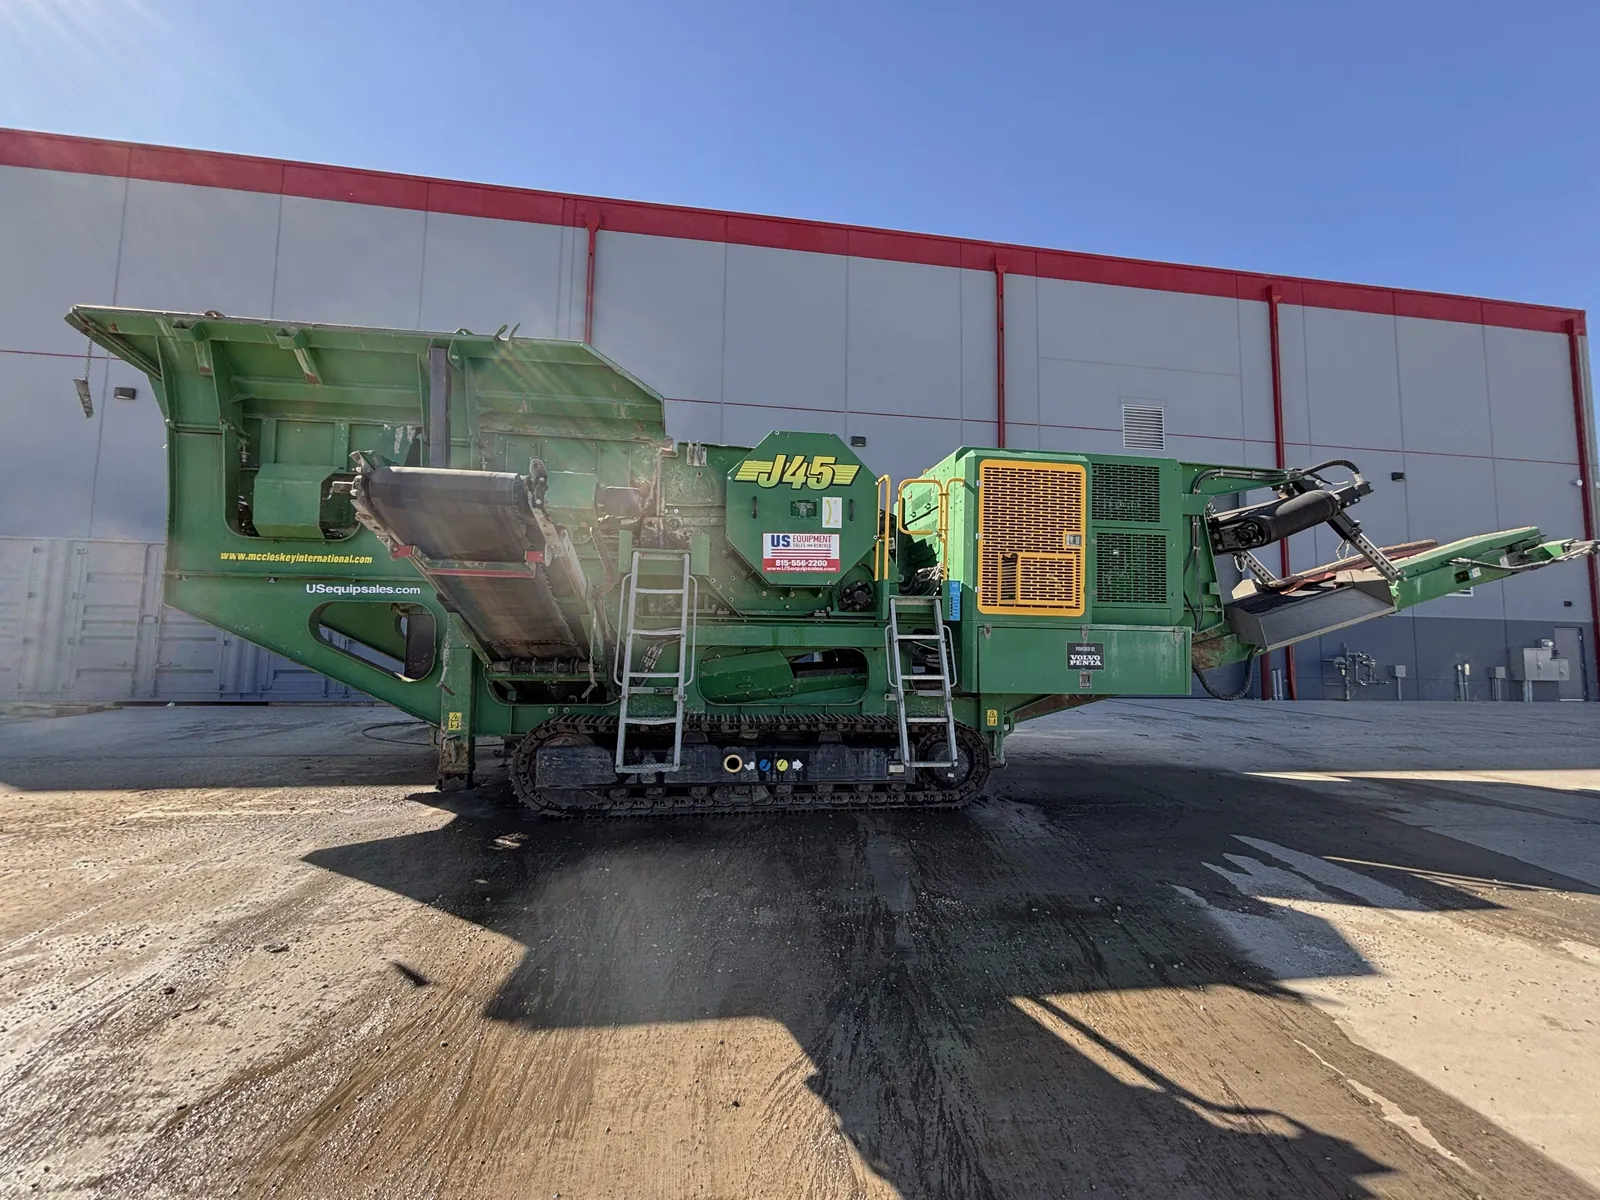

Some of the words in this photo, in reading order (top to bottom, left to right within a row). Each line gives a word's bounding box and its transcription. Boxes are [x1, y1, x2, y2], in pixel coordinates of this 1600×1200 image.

[757, 454, 836, 490] J45
[792, 534, 832, 543] EQUIPMENT
[220, 551, 373, 564] www.mccloskeyinternational.com
[775, 559, 828, 567] 815-556-2200
[306, 583, 421, 596] USequipsales.com
